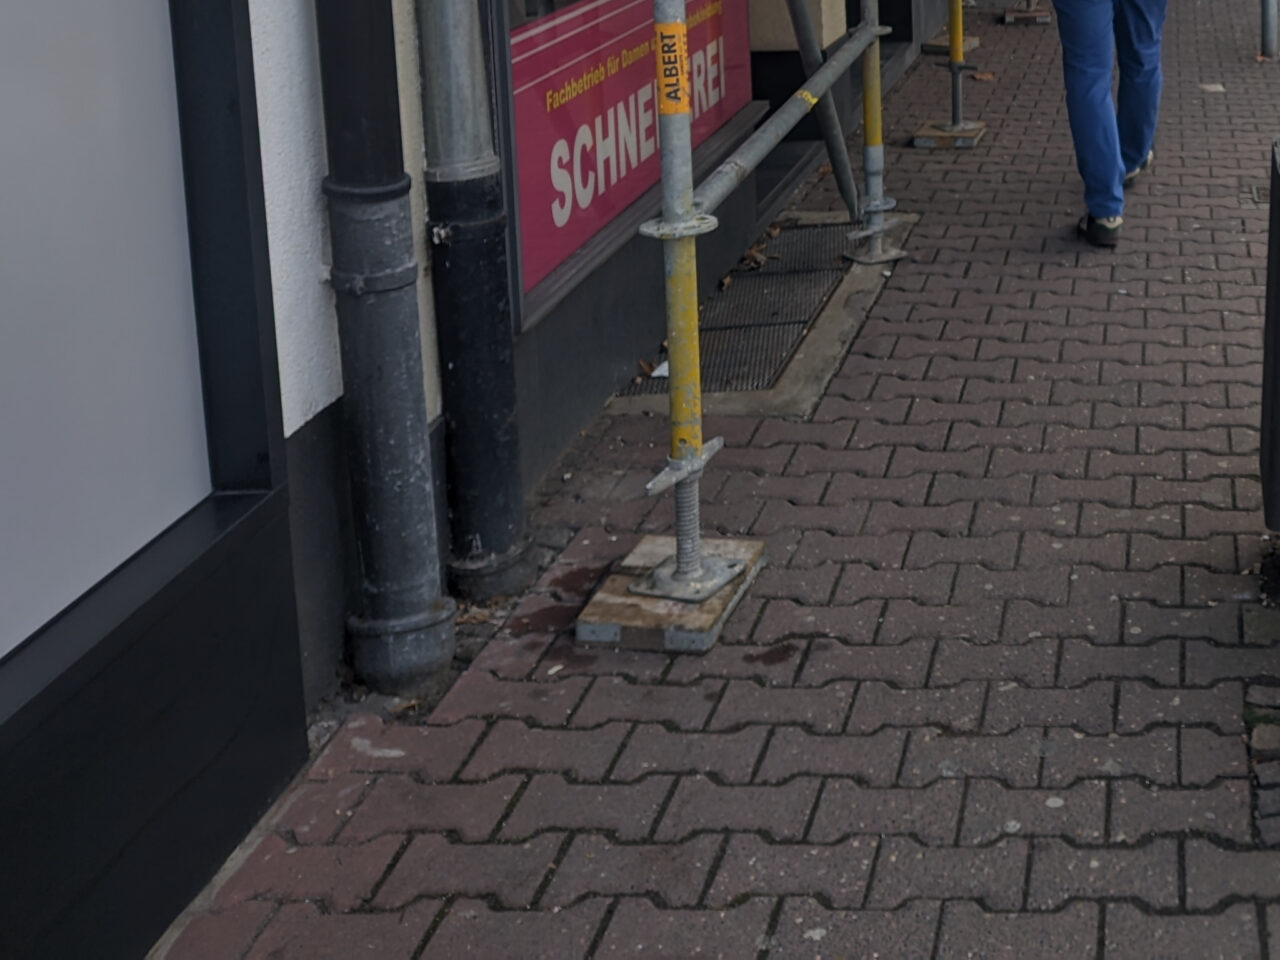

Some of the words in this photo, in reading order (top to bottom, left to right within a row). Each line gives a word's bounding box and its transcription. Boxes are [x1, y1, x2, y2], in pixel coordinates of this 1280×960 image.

[546, 63, 605, 113] Fachbetrieb
[607, 55, 620, 77] für
[621, 41, 649, 67] Damen
[660, 31, 682, 103] ALBERT
[550, 35, 726, 228] SCHNEIREI
